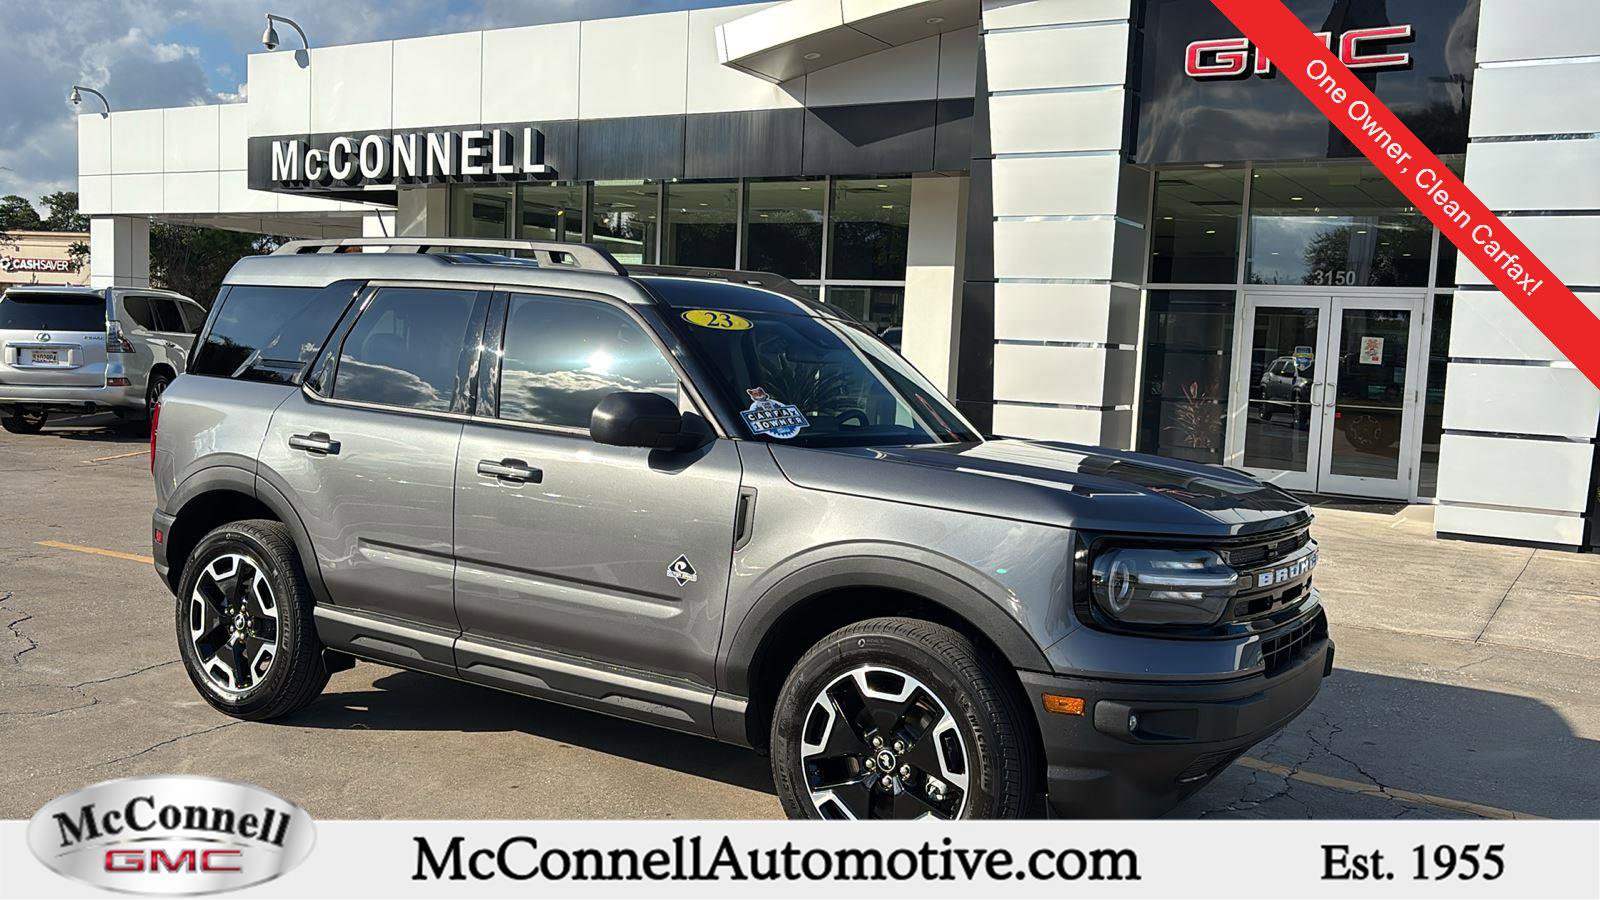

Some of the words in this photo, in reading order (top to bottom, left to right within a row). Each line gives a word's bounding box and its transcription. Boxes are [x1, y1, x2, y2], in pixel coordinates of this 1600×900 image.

[271, 127, 545, 181] McCONNELL
[1313, 270, 1356, 286] 3150
[704, 312, 733, 327] 23
[747, 408, 799, 421] CARFAX
[762, 417, 803, 429] OWNER
[1258, 553, 1317, 588] BRONC
[966, 712, 991, 792] MICHELIN
